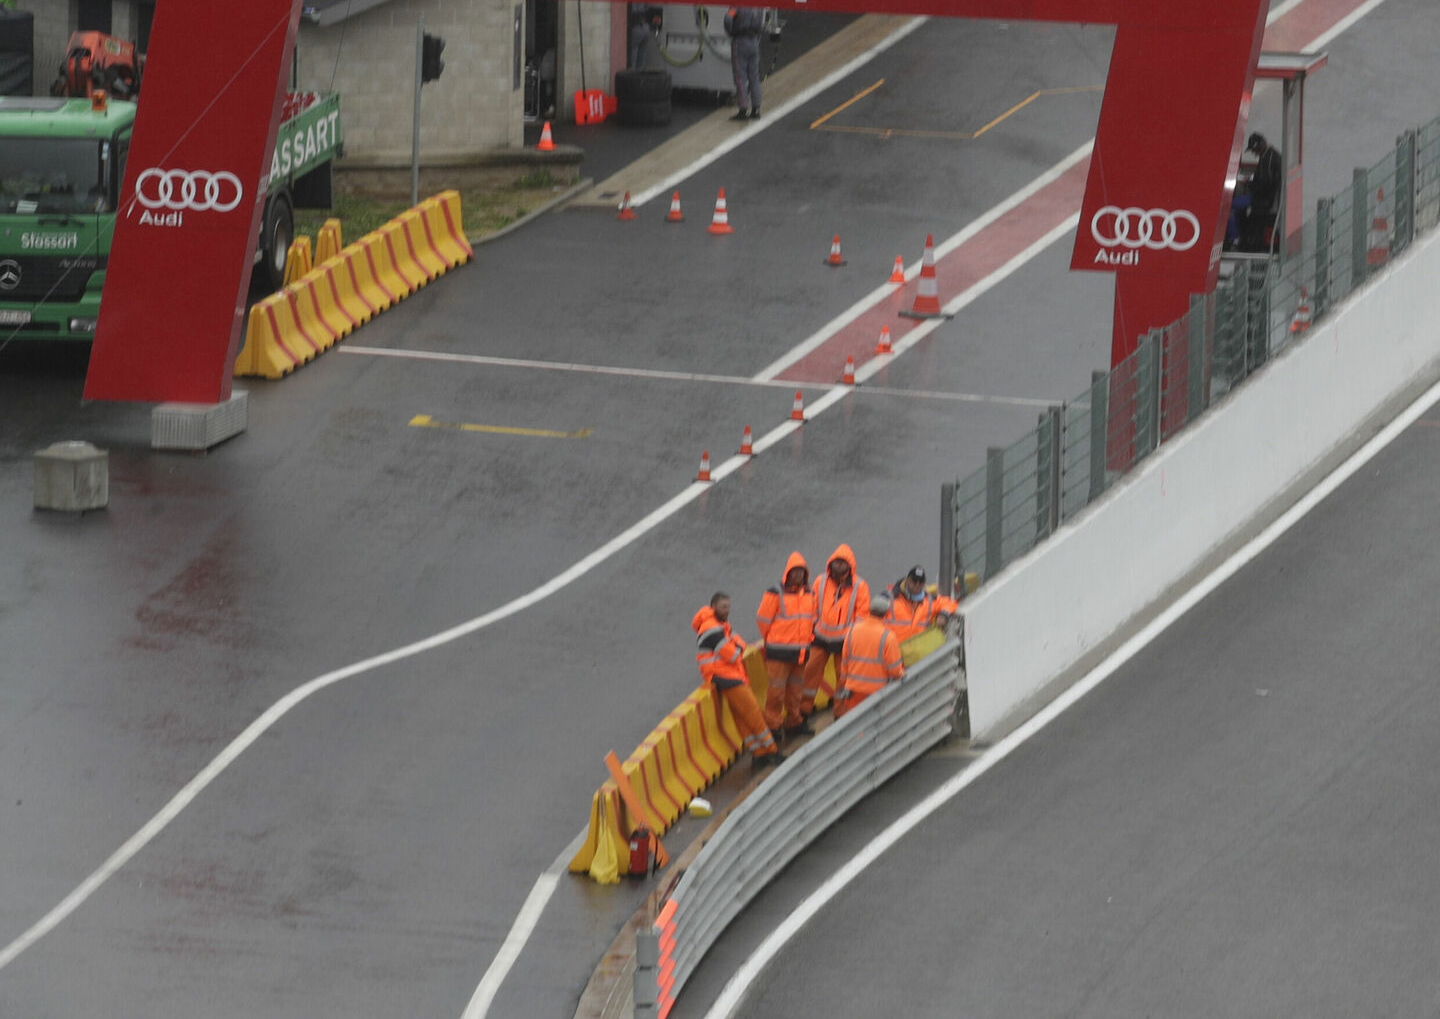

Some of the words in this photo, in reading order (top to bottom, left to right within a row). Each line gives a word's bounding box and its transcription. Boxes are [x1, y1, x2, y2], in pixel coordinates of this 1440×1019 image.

[138, 209, 183, 227] Audi
[21, 231, 78, 249] Stassart
[1094, 247, 1139, 266] Audi
